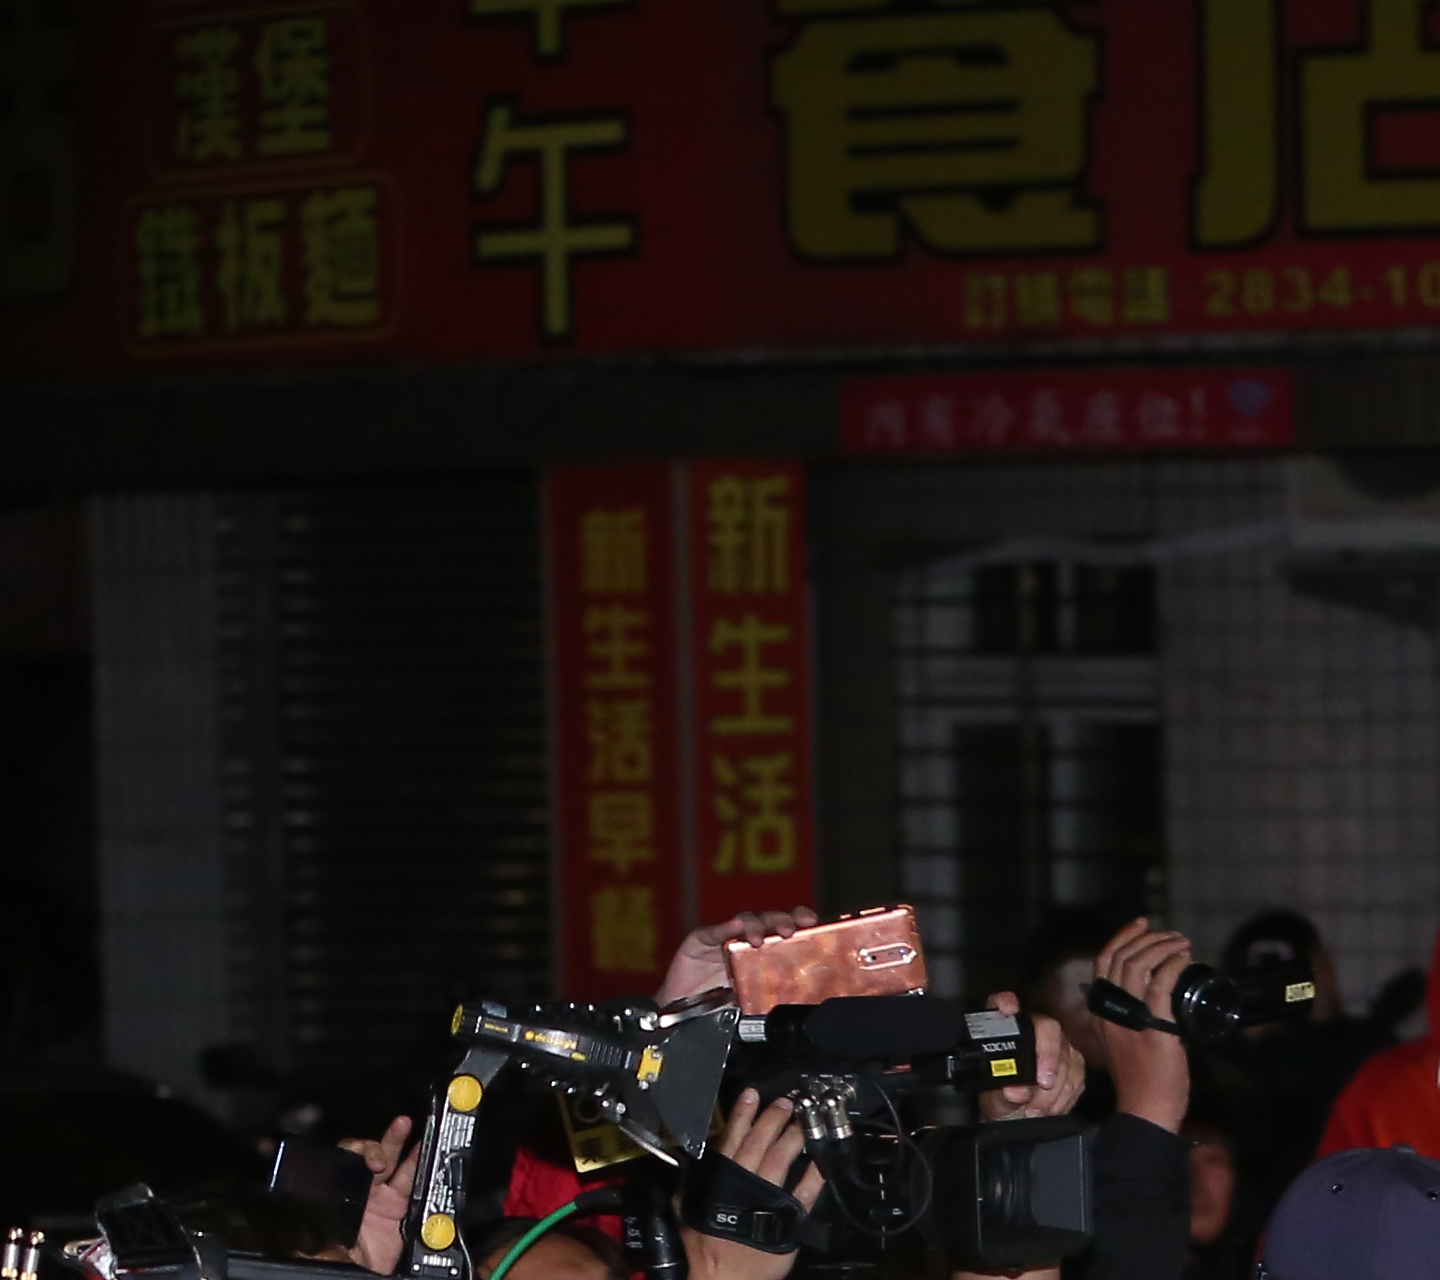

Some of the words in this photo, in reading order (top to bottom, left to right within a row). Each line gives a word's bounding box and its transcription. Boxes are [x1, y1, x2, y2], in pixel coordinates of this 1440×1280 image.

[706, 475, 796, 875] 新生活
[716, 1212, 739, 1225] SC
